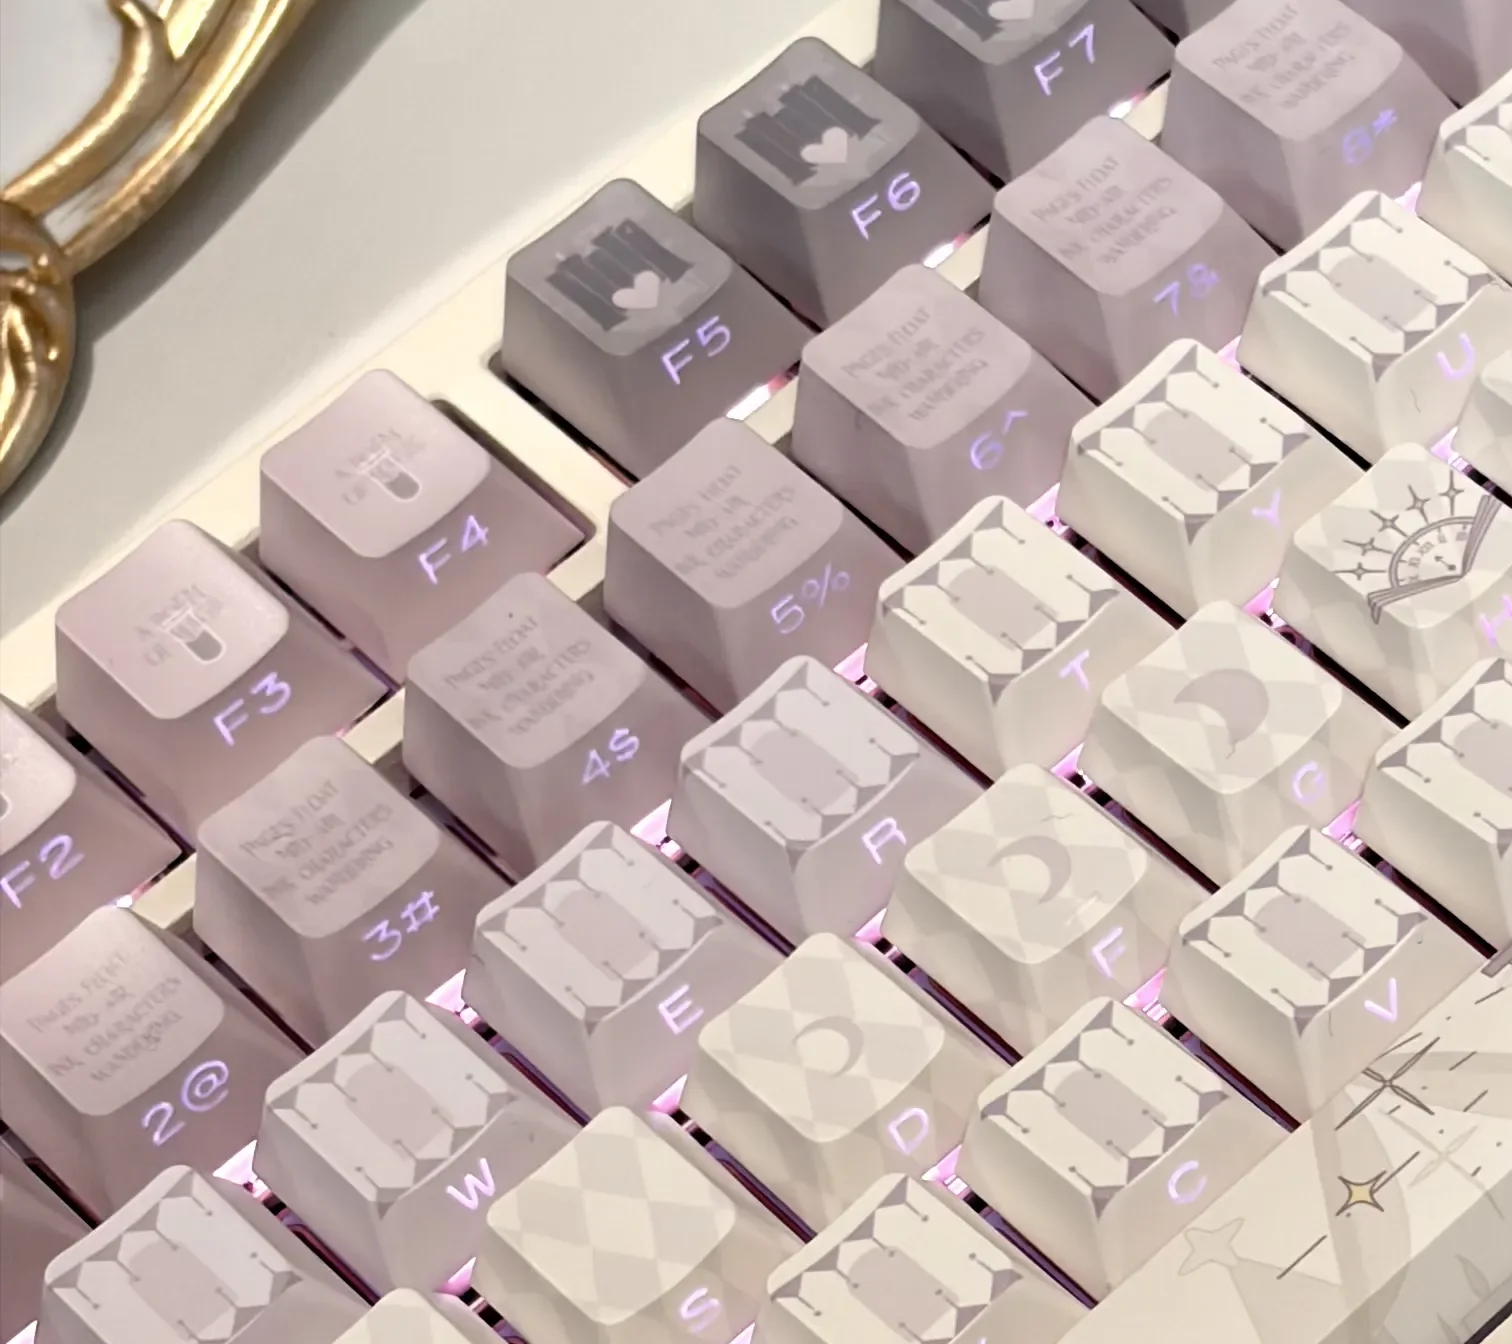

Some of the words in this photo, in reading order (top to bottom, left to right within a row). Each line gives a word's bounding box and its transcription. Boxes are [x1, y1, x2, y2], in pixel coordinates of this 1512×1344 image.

[1032, 22, 1101, 96] F7
[849, 171, 921, 242] F6
[660, 315, 732, 386] F5
[1436, 332, 1476, 381] U
[1252, 488, 1283, 530] Y
[417, 514, 490, 585] F4
[769, 560, 850, 635] 5%
[1058, 648, 1090, 691] T
[212, 670, 292, 747] F3
[1291, 762, 1326, 804] G
[861, 815, 907, 865] R
[0, 833, 85, 910] F2
[361, 889, 440, 961] 3#
[1091, 927, 1124, 978] F
[657, 984, 703, 1035] E
[1363, 977, 1398, 1022] V
[141, 1059, 230, 1146] 2@
[888, 1107, 931, 1154] D
[446, 1158, 496, 1211] W
[1167, 1160, 1207, 1205] C
[679, 1287, 721, 1333] S
